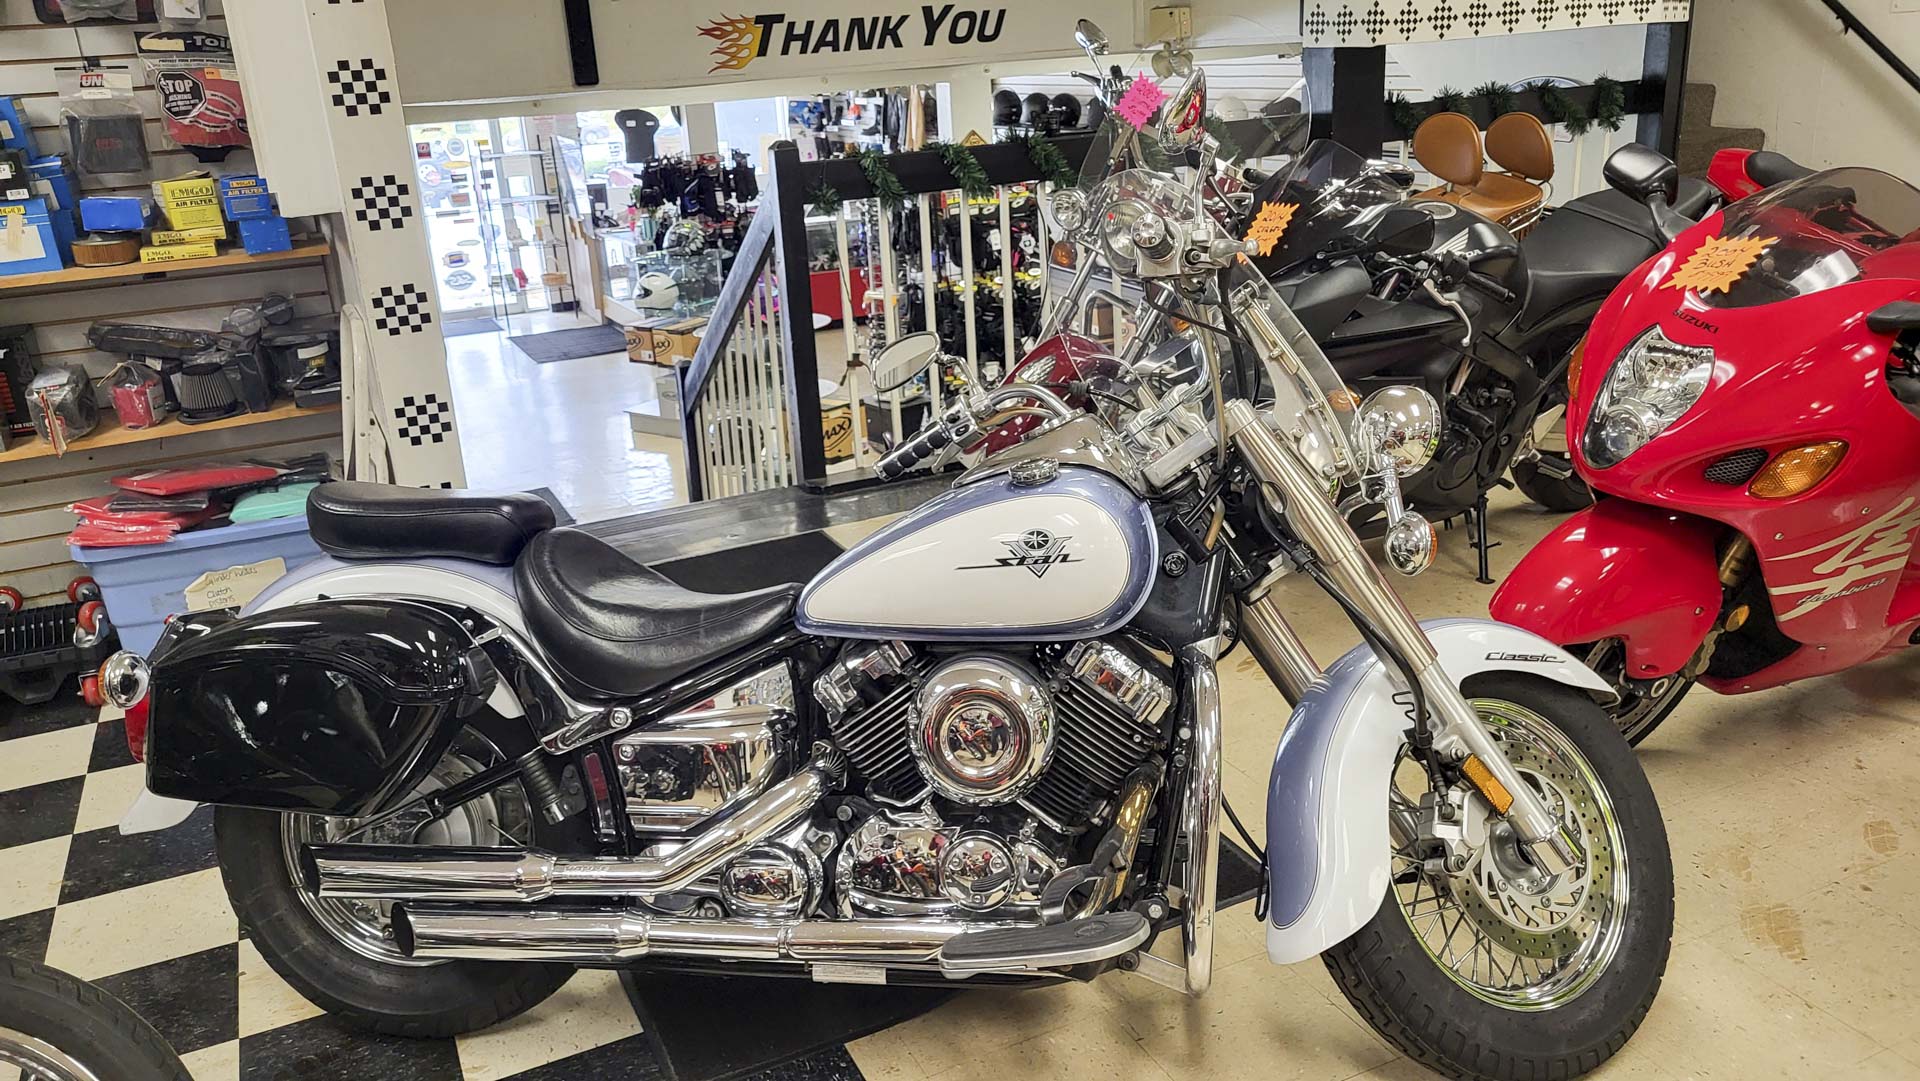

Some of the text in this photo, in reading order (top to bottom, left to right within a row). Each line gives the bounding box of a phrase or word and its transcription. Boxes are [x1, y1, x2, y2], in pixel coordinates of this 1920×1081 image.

[81, 75, 103, 87] UN
[160, 78, 193, 94] STOP
[170, 186, 212, 199] EMGO
[1672, 309, 1720, 335] SUZUKI
[1484, 651, 1567, 664] Classic
